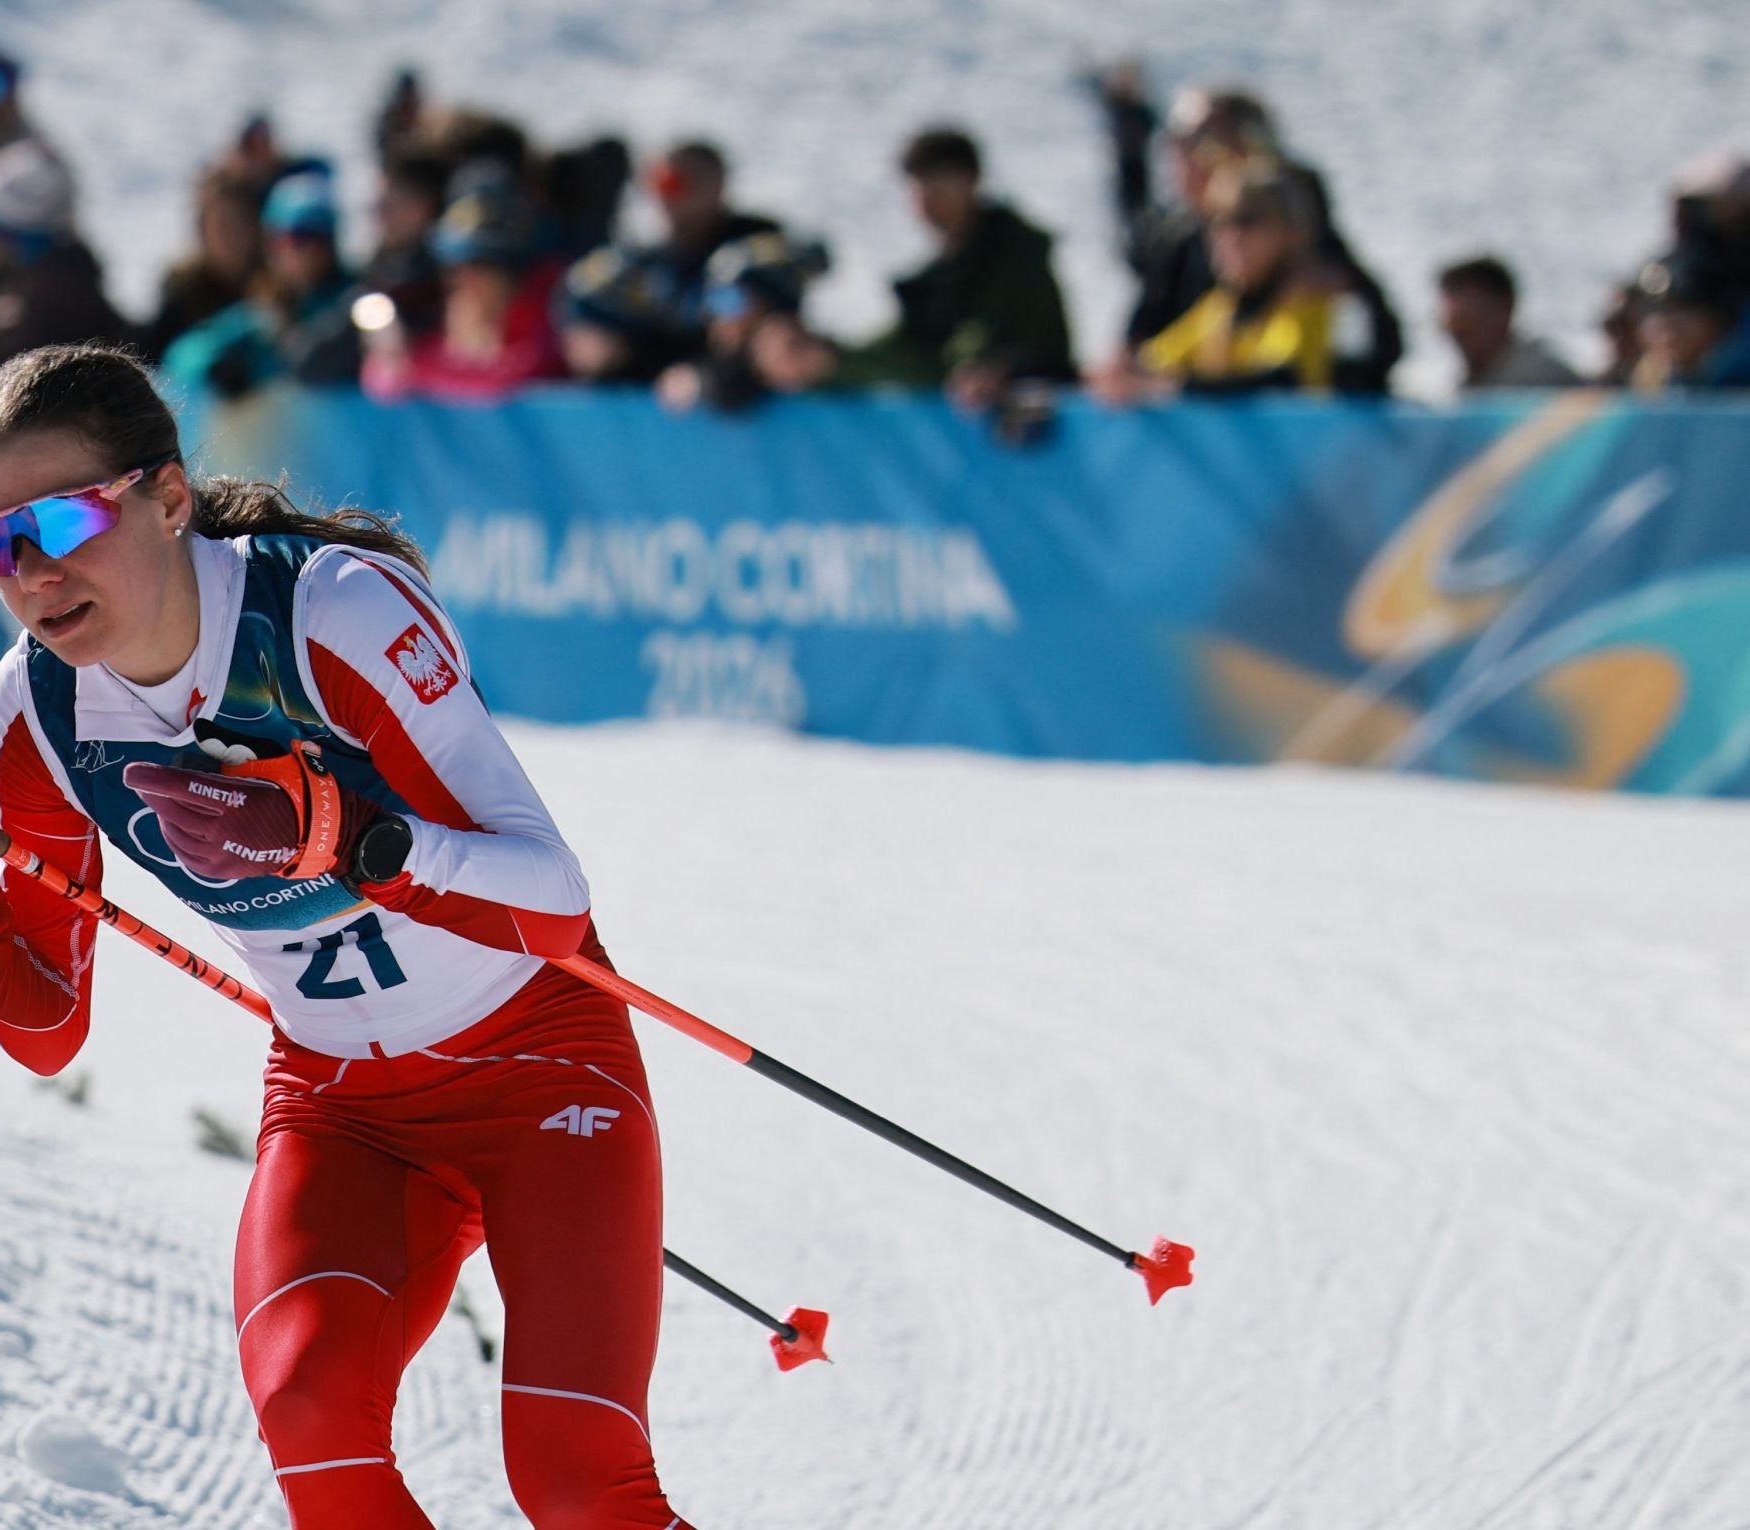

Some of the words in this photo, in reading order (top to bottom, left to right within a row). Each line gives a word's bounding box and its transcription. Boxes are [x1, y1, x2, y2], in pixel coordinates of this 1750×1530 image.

[432, 512, 710, 622] MILANO
[716, 518, 1018, 634] CORTINA
[317, 778, 333, 852] ONE/WAY
[179, 897, 249, 914] MILANO
[282, 912, 408, 999] 21
[539, 1104, 621, 1137] 4F
